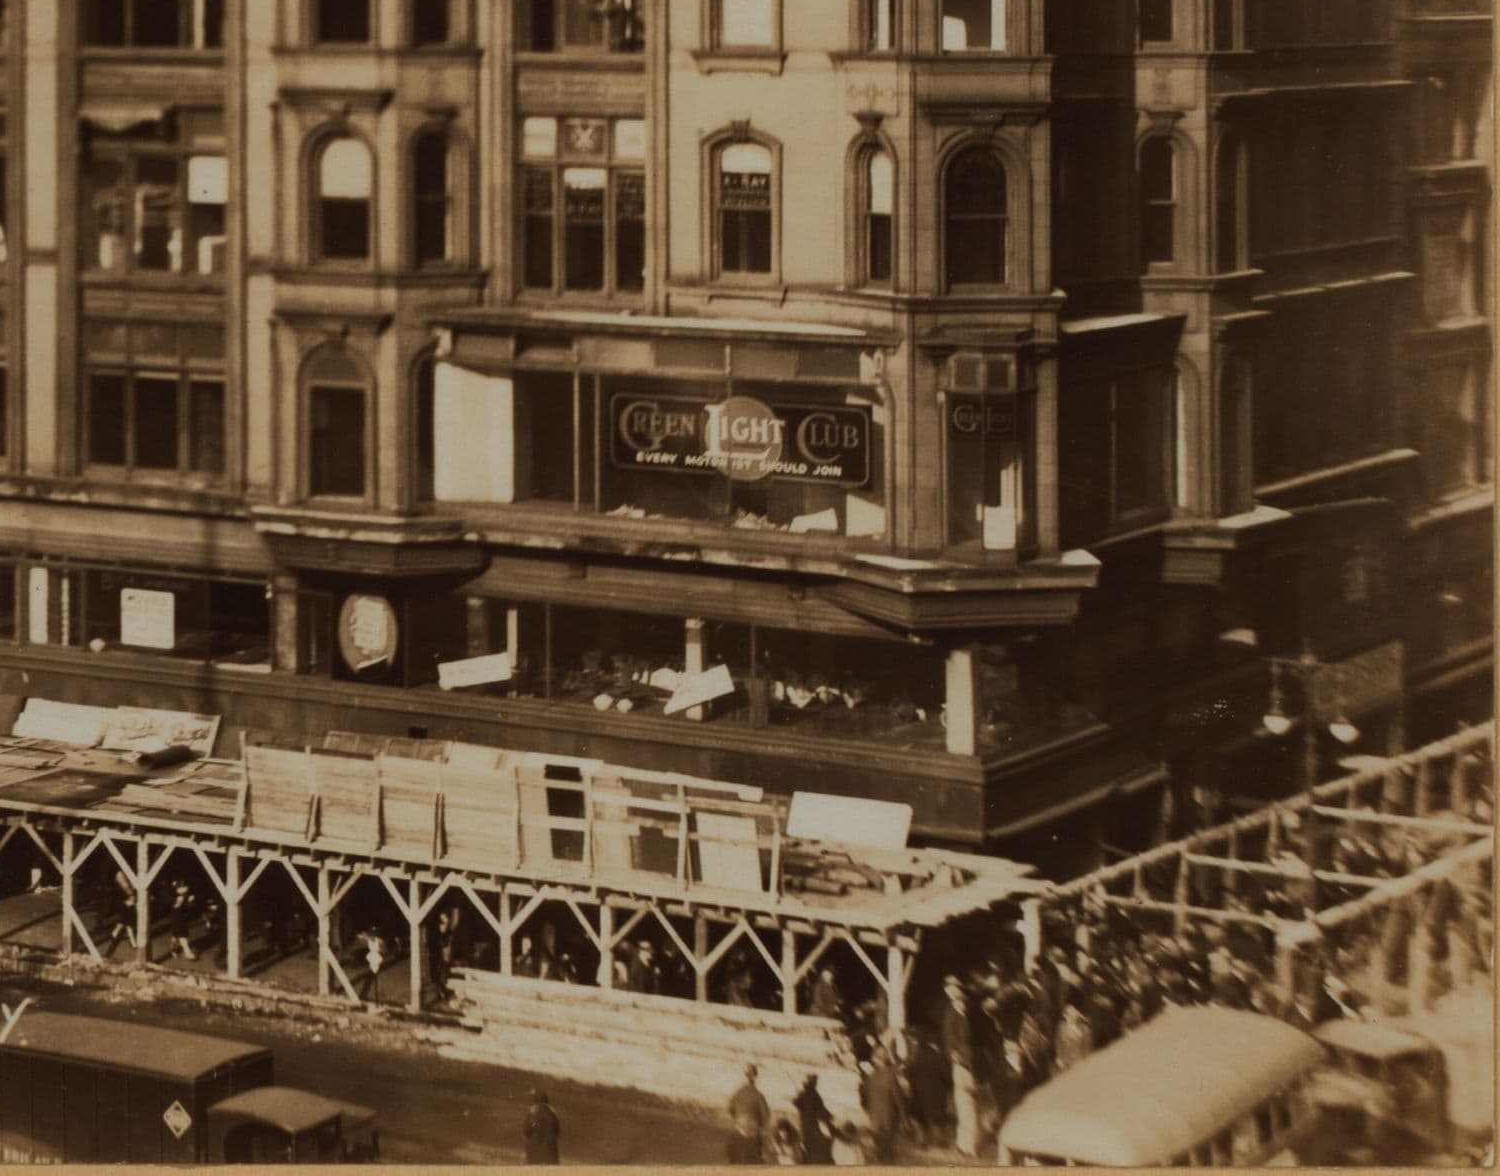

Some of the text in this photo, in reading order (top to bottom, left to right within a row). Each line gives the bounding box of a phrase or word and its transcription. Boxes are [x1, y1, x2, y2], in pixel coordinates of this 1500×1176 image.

[619, 400, 860, 464] GREEN LIGHT CLUB
[635, 451, 678, 464] EVERY
[758, 460, 808, 475] SHOULD
[812, 464, 843, 478] JOIN
